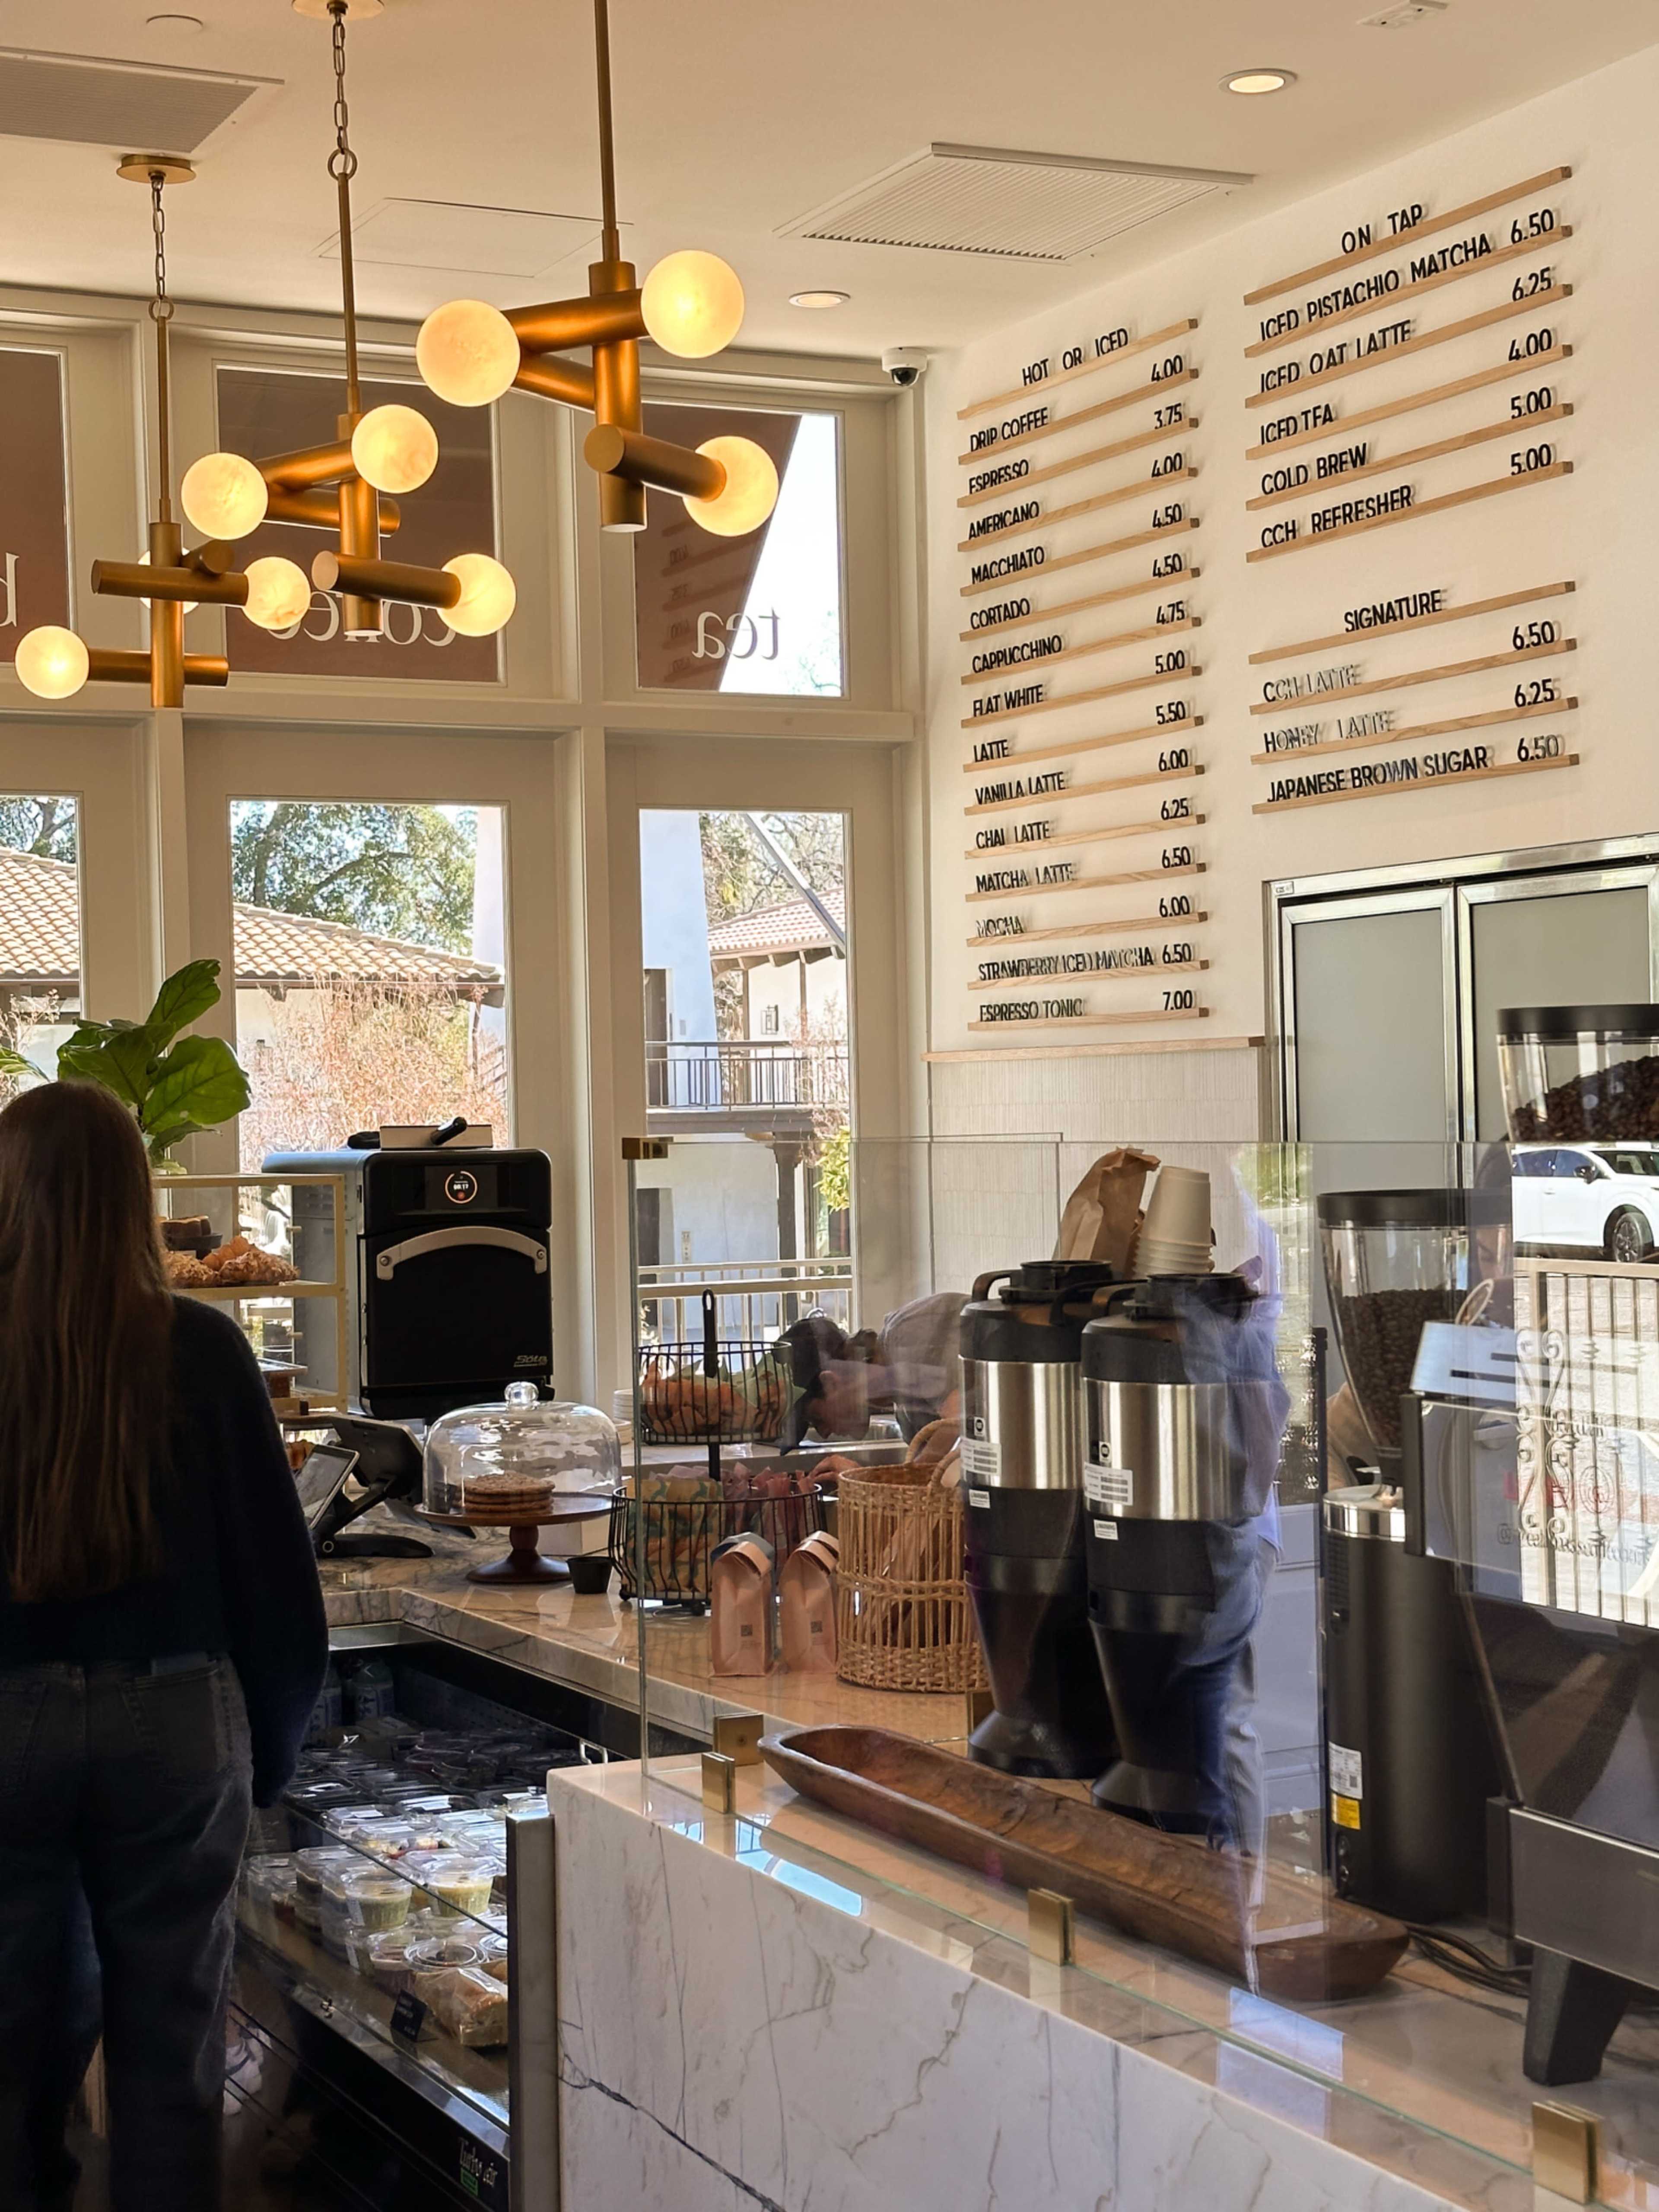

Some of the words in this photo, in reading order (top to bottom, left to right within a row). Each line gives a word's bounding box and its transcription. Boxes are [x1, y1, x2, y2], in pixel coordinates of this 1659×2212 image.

[1342, 224, 1371, 254] ON
[1388, 203, 1422, 235] TAP
[1261, 309, 1299, 341] ICED
[1307, 269, 1400, 323] PISTACHIO
[1411, 233, 1491, 283] MATCHA
[1511, 209, 1554, 245] 6.50
[1022, 359, 1049, 386] HOT
[1063, 348, 1081, 370] OR
[1095, 328, 1128, 357] ICED
[1261, 362, 1299, 394] ICED
[1309, 343, 1348, 375] OAT
[1357, 319, 1411, 359] LATTE
[1512, 267, 1552, 302] 6.25
[970, 428, 997, 452] DRIP
[1002, 407, 1048, 440] COFFEE
[1151, 355, 1183, 382] 4.00
[1261, 414, 1297, 445] ICED
[1301, 404, 1334, 431] TEA
[1508, 328, 1552, 362] 4.00
[969, 460, 1028, 494] ESPRESSO
[1154, 403, 1182, 429] 3.75
[1262, 464, 1308, 496] COLD
[1317, 443, 1367, 479] BREW
[1511, 387, 1552, 420] 5.00
[969, 501, 1039, 540] AMERICANO
[1151, 453, 1182, 478] 4.00
[1262, 520, 1297, 548] CCH
[1311, 485, 1412, 534] REFRESHER
[1511, 443, 1552, 476] 5.00
[972, 546, 1044, 584] MACCHIATO
[1152, 503, 1182, 528] 4.50
[970, 598, 1030, 629] CORTADO
[1152, 553, 1182, 578] 4.50
[1344, 589, 1443, 632] SIGNATURE
[972, 635, 1062, 673] CAPPUCCHINO
[1156, 601, 1185, 625] 4.75
[1513, 621, 1554, 650] 6.50
[973, 695, 1001, 718] FLAT
[1004, 684, 1043, 710] WHITE
[1155, 650, 1185, 674] 5.00
[1515, 678, 1554, 708] 6.25
[974, 739, 1008, 762] LATTE
[1156, 701, 1185, 725] 5.50
[976, 780, 1025, 805] VANILLA
[1028, 772, 1065, 794] LATTE
[1159, 749, 1188, 772] 6.00
[1268, 769, 1345, 803] JAPANESE
[1352, 758, 1418, 788] BROWN
[1424, 746, 1487, 777] SUGAR
[1517, 735, 1558, 762] 6.50
[976, 828, 1005, 849] CHAI
[1014, 821, 1051, 842] LATTE
[1161, 798, 1189, 820] 6.25
[976, 871, 1027, 893] MATCHA
[1036, 863, 1073, 885] LATTE
[1162, 846, 1191, 868] 6.50
[1159, 896, 1190, 917] 6.00
[1162, 943, 1191, 964] 6.50
[980, 1001, 1039, 1022] ESPRESSO
[1043, 998, 1083, 1018] TONIC
[1162, 990, 1192, 1010] 7.00
